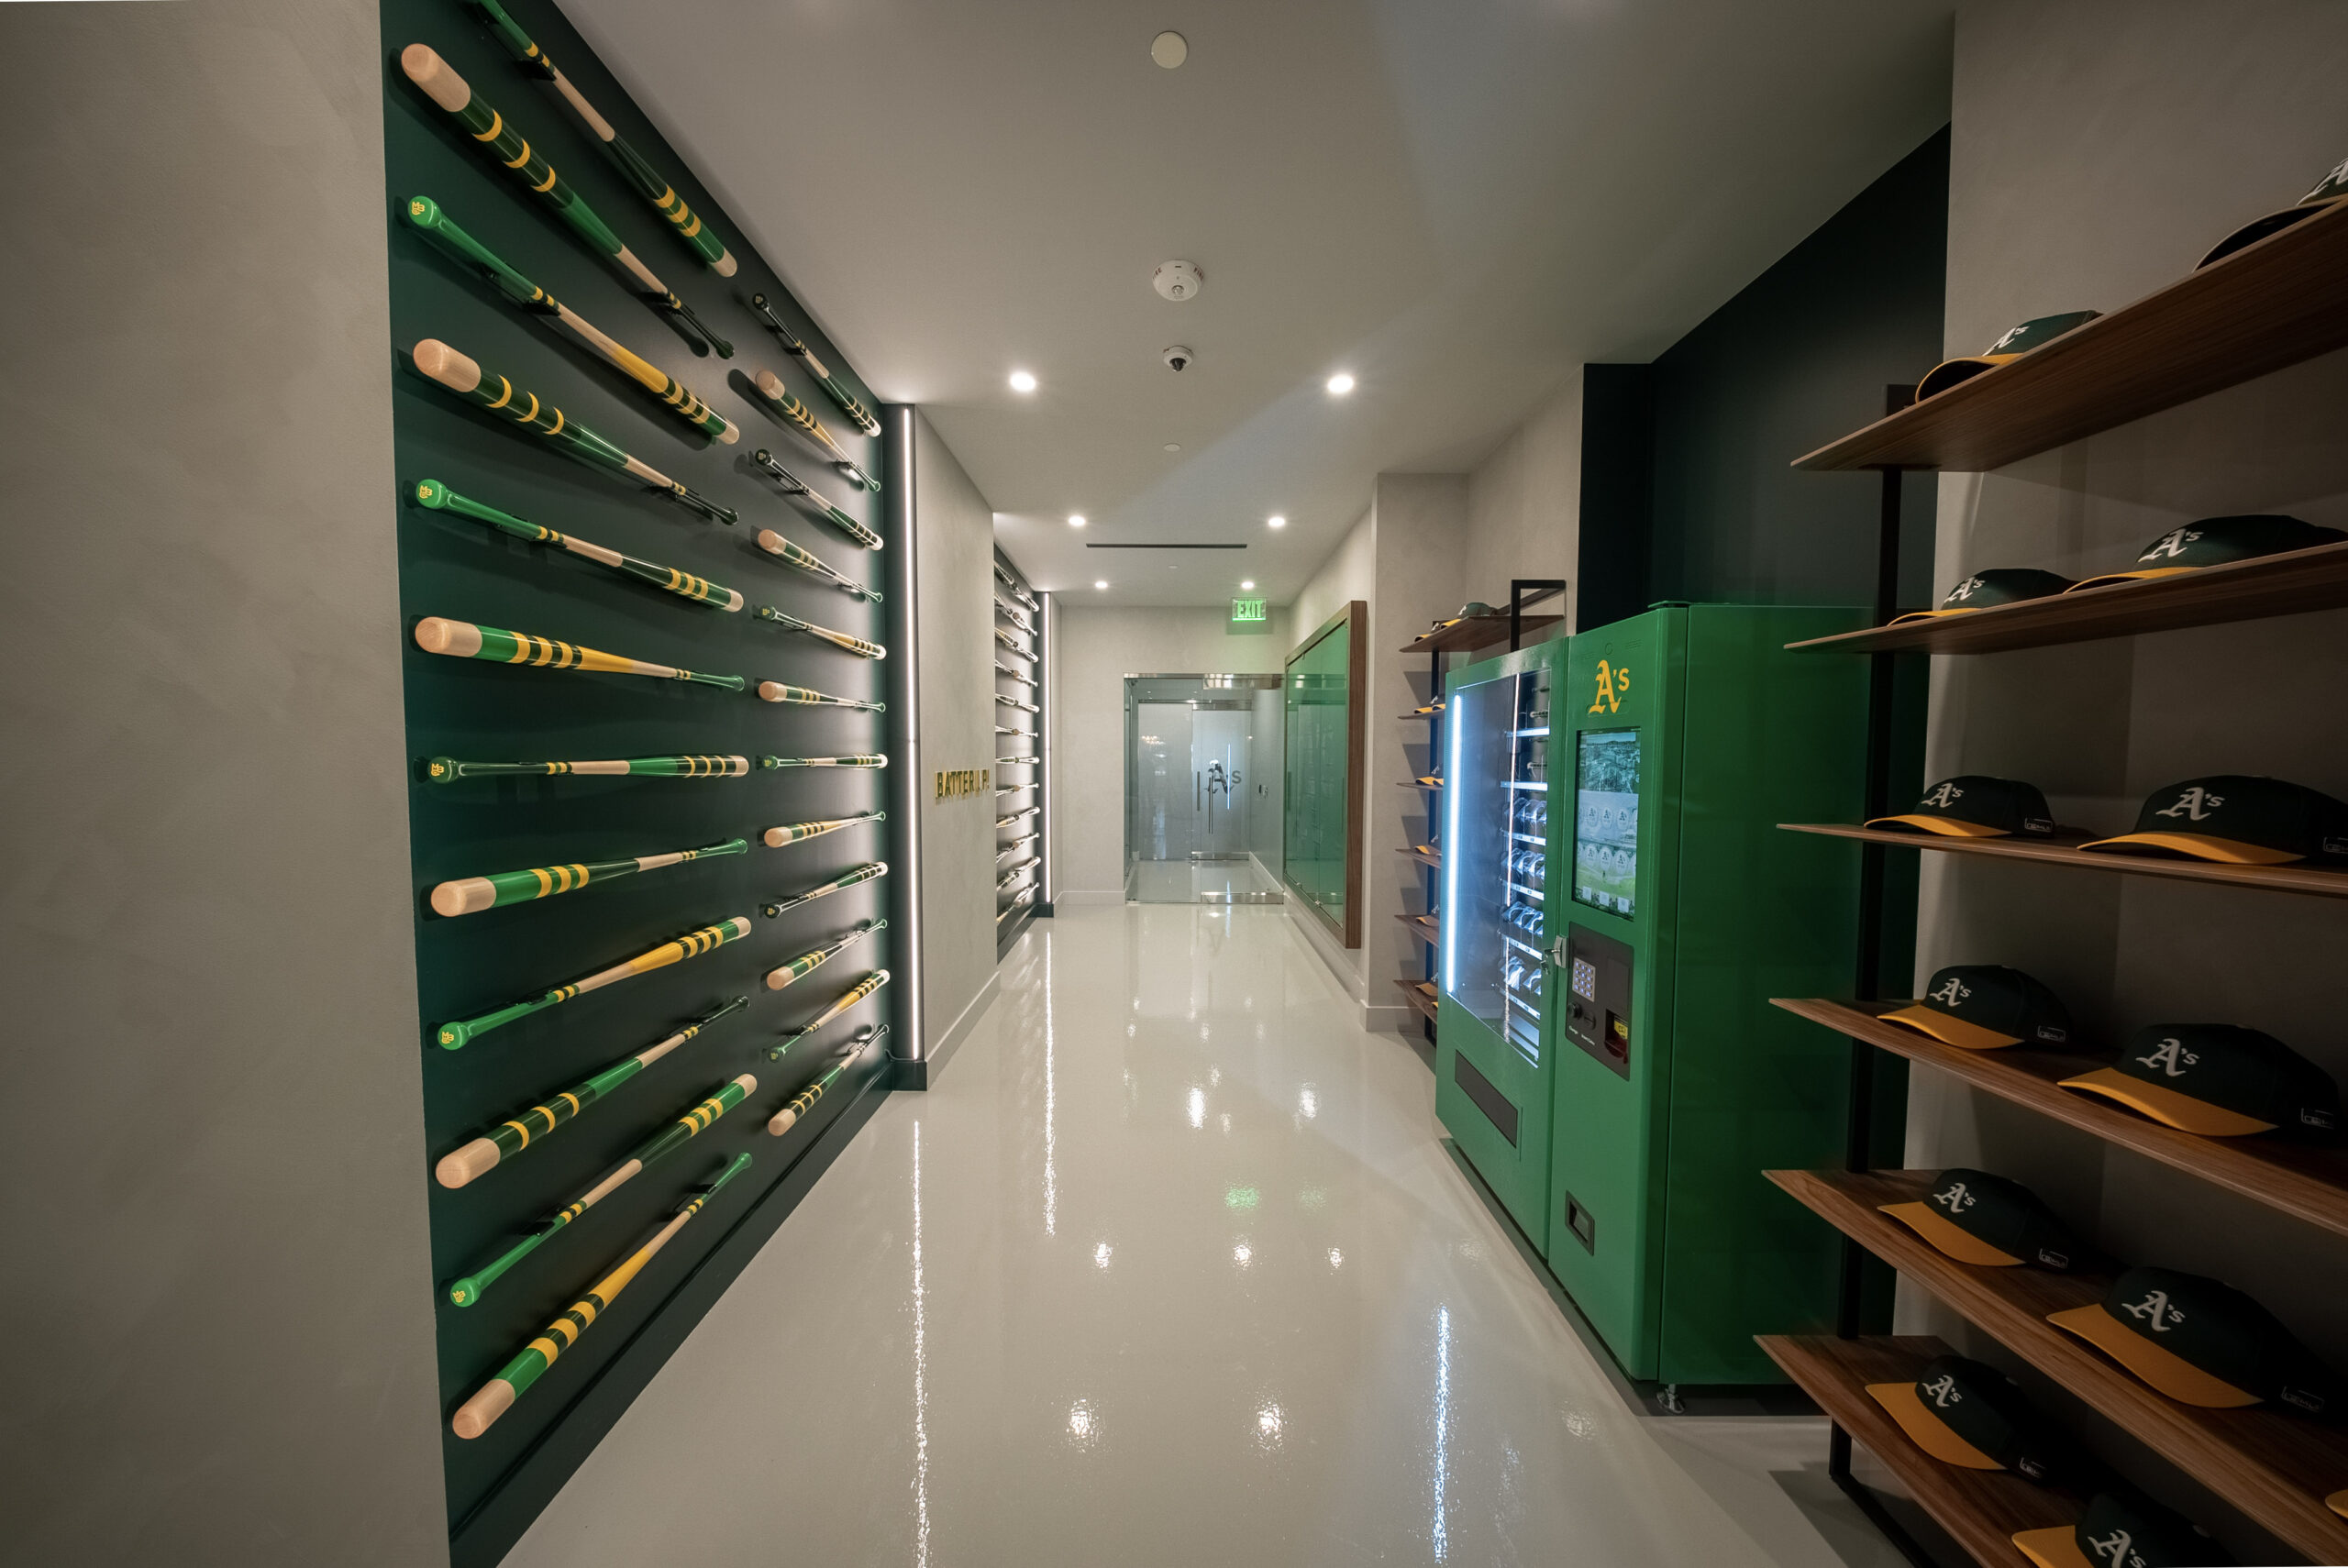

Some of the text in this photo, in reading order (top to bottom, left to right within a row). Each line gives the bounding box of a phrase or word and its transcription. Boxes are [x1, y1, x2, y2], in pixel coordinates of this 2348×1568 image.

[2138, 528, 2204, 562] A's
[1944, 577, 1985, 602] A's
[1237, 601, 1263, 618] EXIT
[1588, 659, 1629, 714] A's
[1922, 782, 1965, 808] A's
[2155, 787, 2225, 821] A's
[1929, 977, 1972, 1007] A's
[2135, 1038, 2200, 1077] A's
[1933, 1182, 1977, 1213] A's
[2121, 1290, 2186, 1331] A's
[1922, 1375, 1963, 1408] A's
